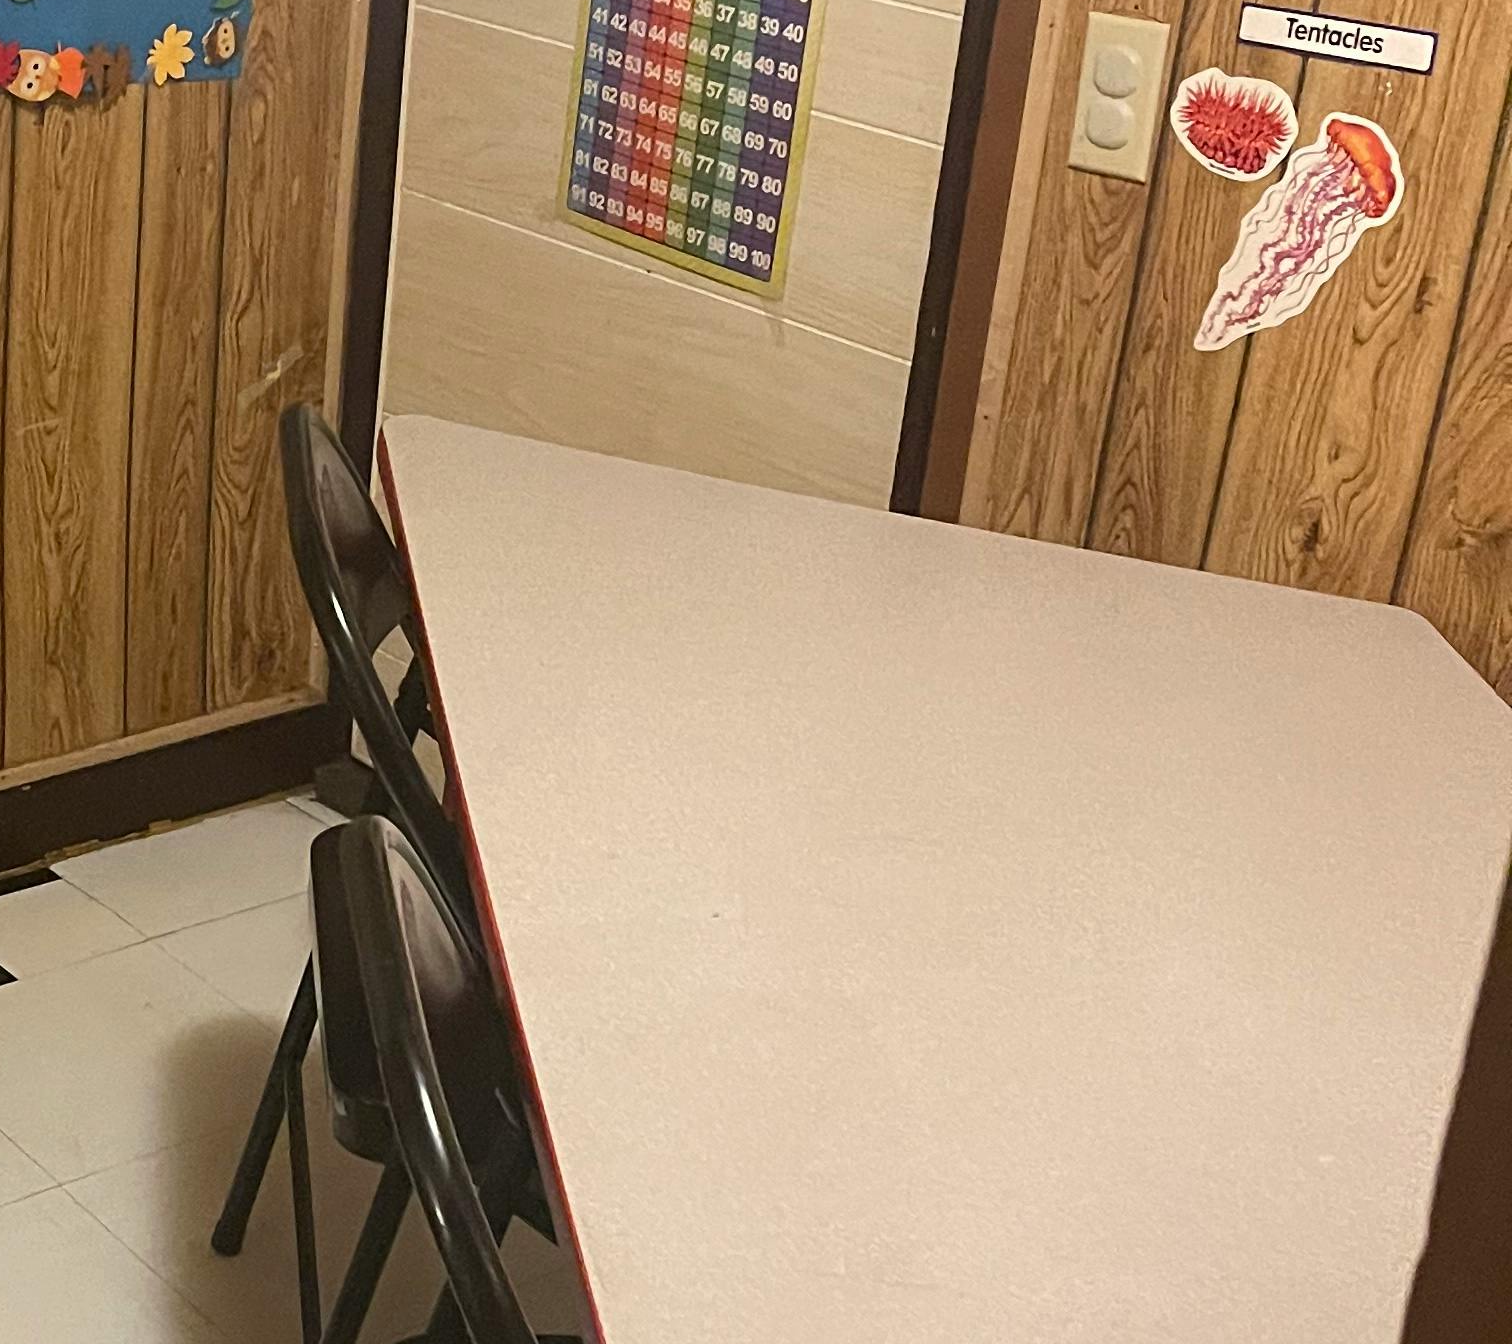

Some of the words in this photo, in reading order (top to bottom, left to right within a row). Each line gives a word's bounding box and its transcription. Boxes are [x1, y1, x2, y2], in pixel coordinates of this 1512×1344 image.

[592, 7, 608, 25] 41
[610, 13, 627, 32] 42
[629, 19, 646, 38] 43
[668, 31, 687, 50] 45
[710, 43, 730, 62] 47
[754, 56, 775, 75] 49
[777, 62, 798, 82] 50
[716, 4, 736, 23] 37
[760, 16, 780, 36] 39
[782, 23, 804, 43] 40
[1285, 16, 1385, 55] Tentacles
[606, 48, 623, 68] 52
[624, 54, 642, 74] 53
[663, 66, 682, 87] 55
[706, 80, 725, 99] 57
[749, 93, 769, 114] 59
[772, 100, 792, 121] 60
[580, 113, 595, 134] 71
[598, 120, 613, 140] 72
[616, 126, 632, 146] 73
[636, 133, 651, 153] 74
[655, 140, 672, 160] 75
[696, 154, 715, 174] 77
[740, 168, 759, 188] 79
[761, 176, 782, 196] 80
[601, 85, 618, 104] 62
[620, 91, 636, 111] 63
[659, 104, 677, 124] 65
[700, 118, 720, 136] 67
[744, 131, 764, 151] 69
[768, 137, 787, 158] 70
[575, 149, 590, 169] 81
[734, 206, 753, 225] 89
[756, 213, 776, 233] 90
[589, 191, 605, 210] 92
[687, 227, 706, 246] 97
[729, 242, 748, 262] 99
